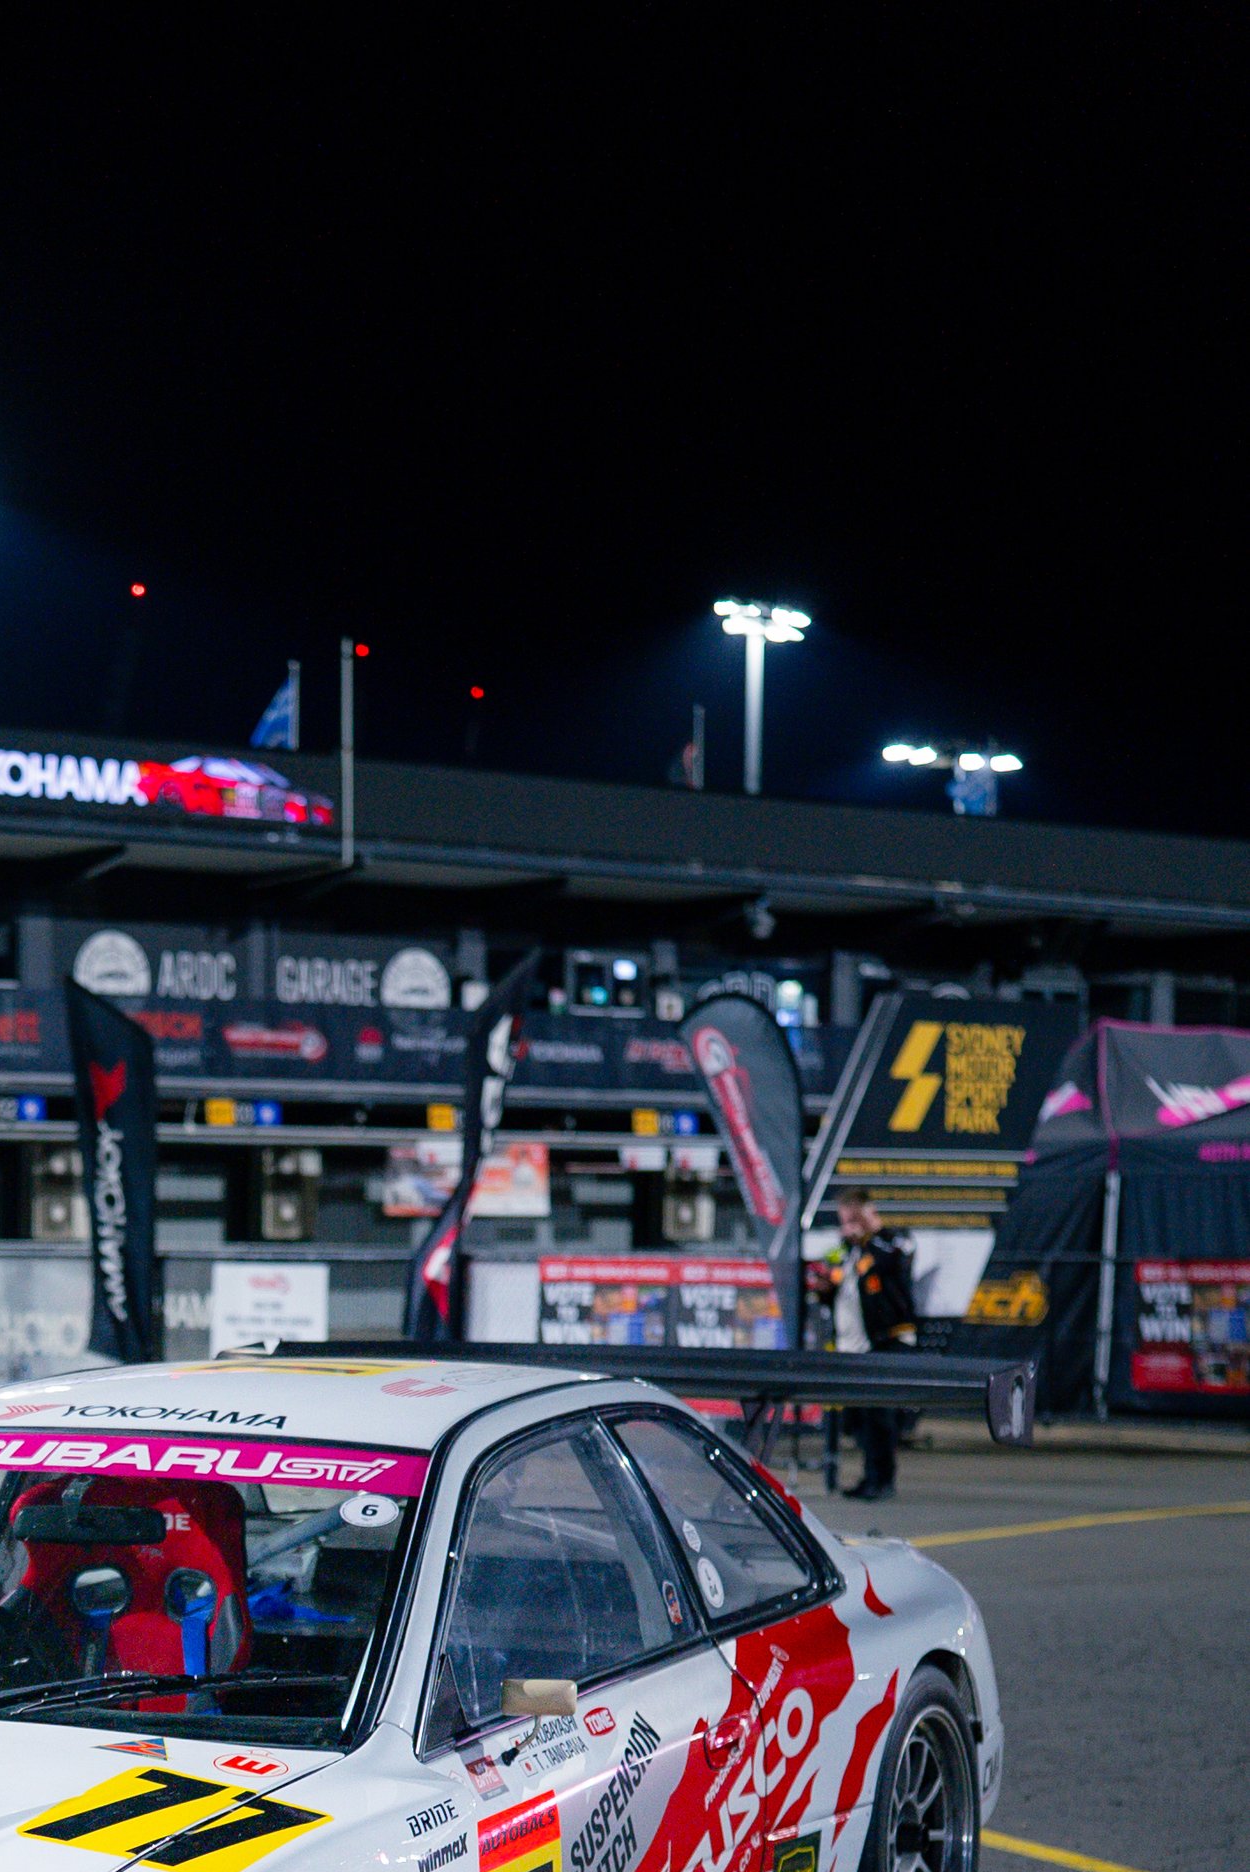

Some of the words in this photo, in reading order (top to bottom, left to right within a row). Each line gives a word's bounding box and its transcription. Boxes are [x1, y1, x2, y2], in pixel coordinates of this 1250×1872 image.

[157, 950, 237, 1001] ARDC
[276, 956, 380, 1009] GARAGE
[946, 1022, 1026, 1056] SYDNEY
[946, 1052, 1017, 1082] MOTOR
[945, 1080, 1011, 1109] SPORT
[944, 1103, 1000, 1133] PARK
[61, 1404, 287, 1429] YOKOHAMA
[360, 1504, 378, 1517] 6
[586, 1710, 613, 1734] TONE
[23, 1768, 327, 1867] 77
[406, 1799, 460, 1838] BRIDE
[480, 1807, 556, 1856] AUTOBACS
